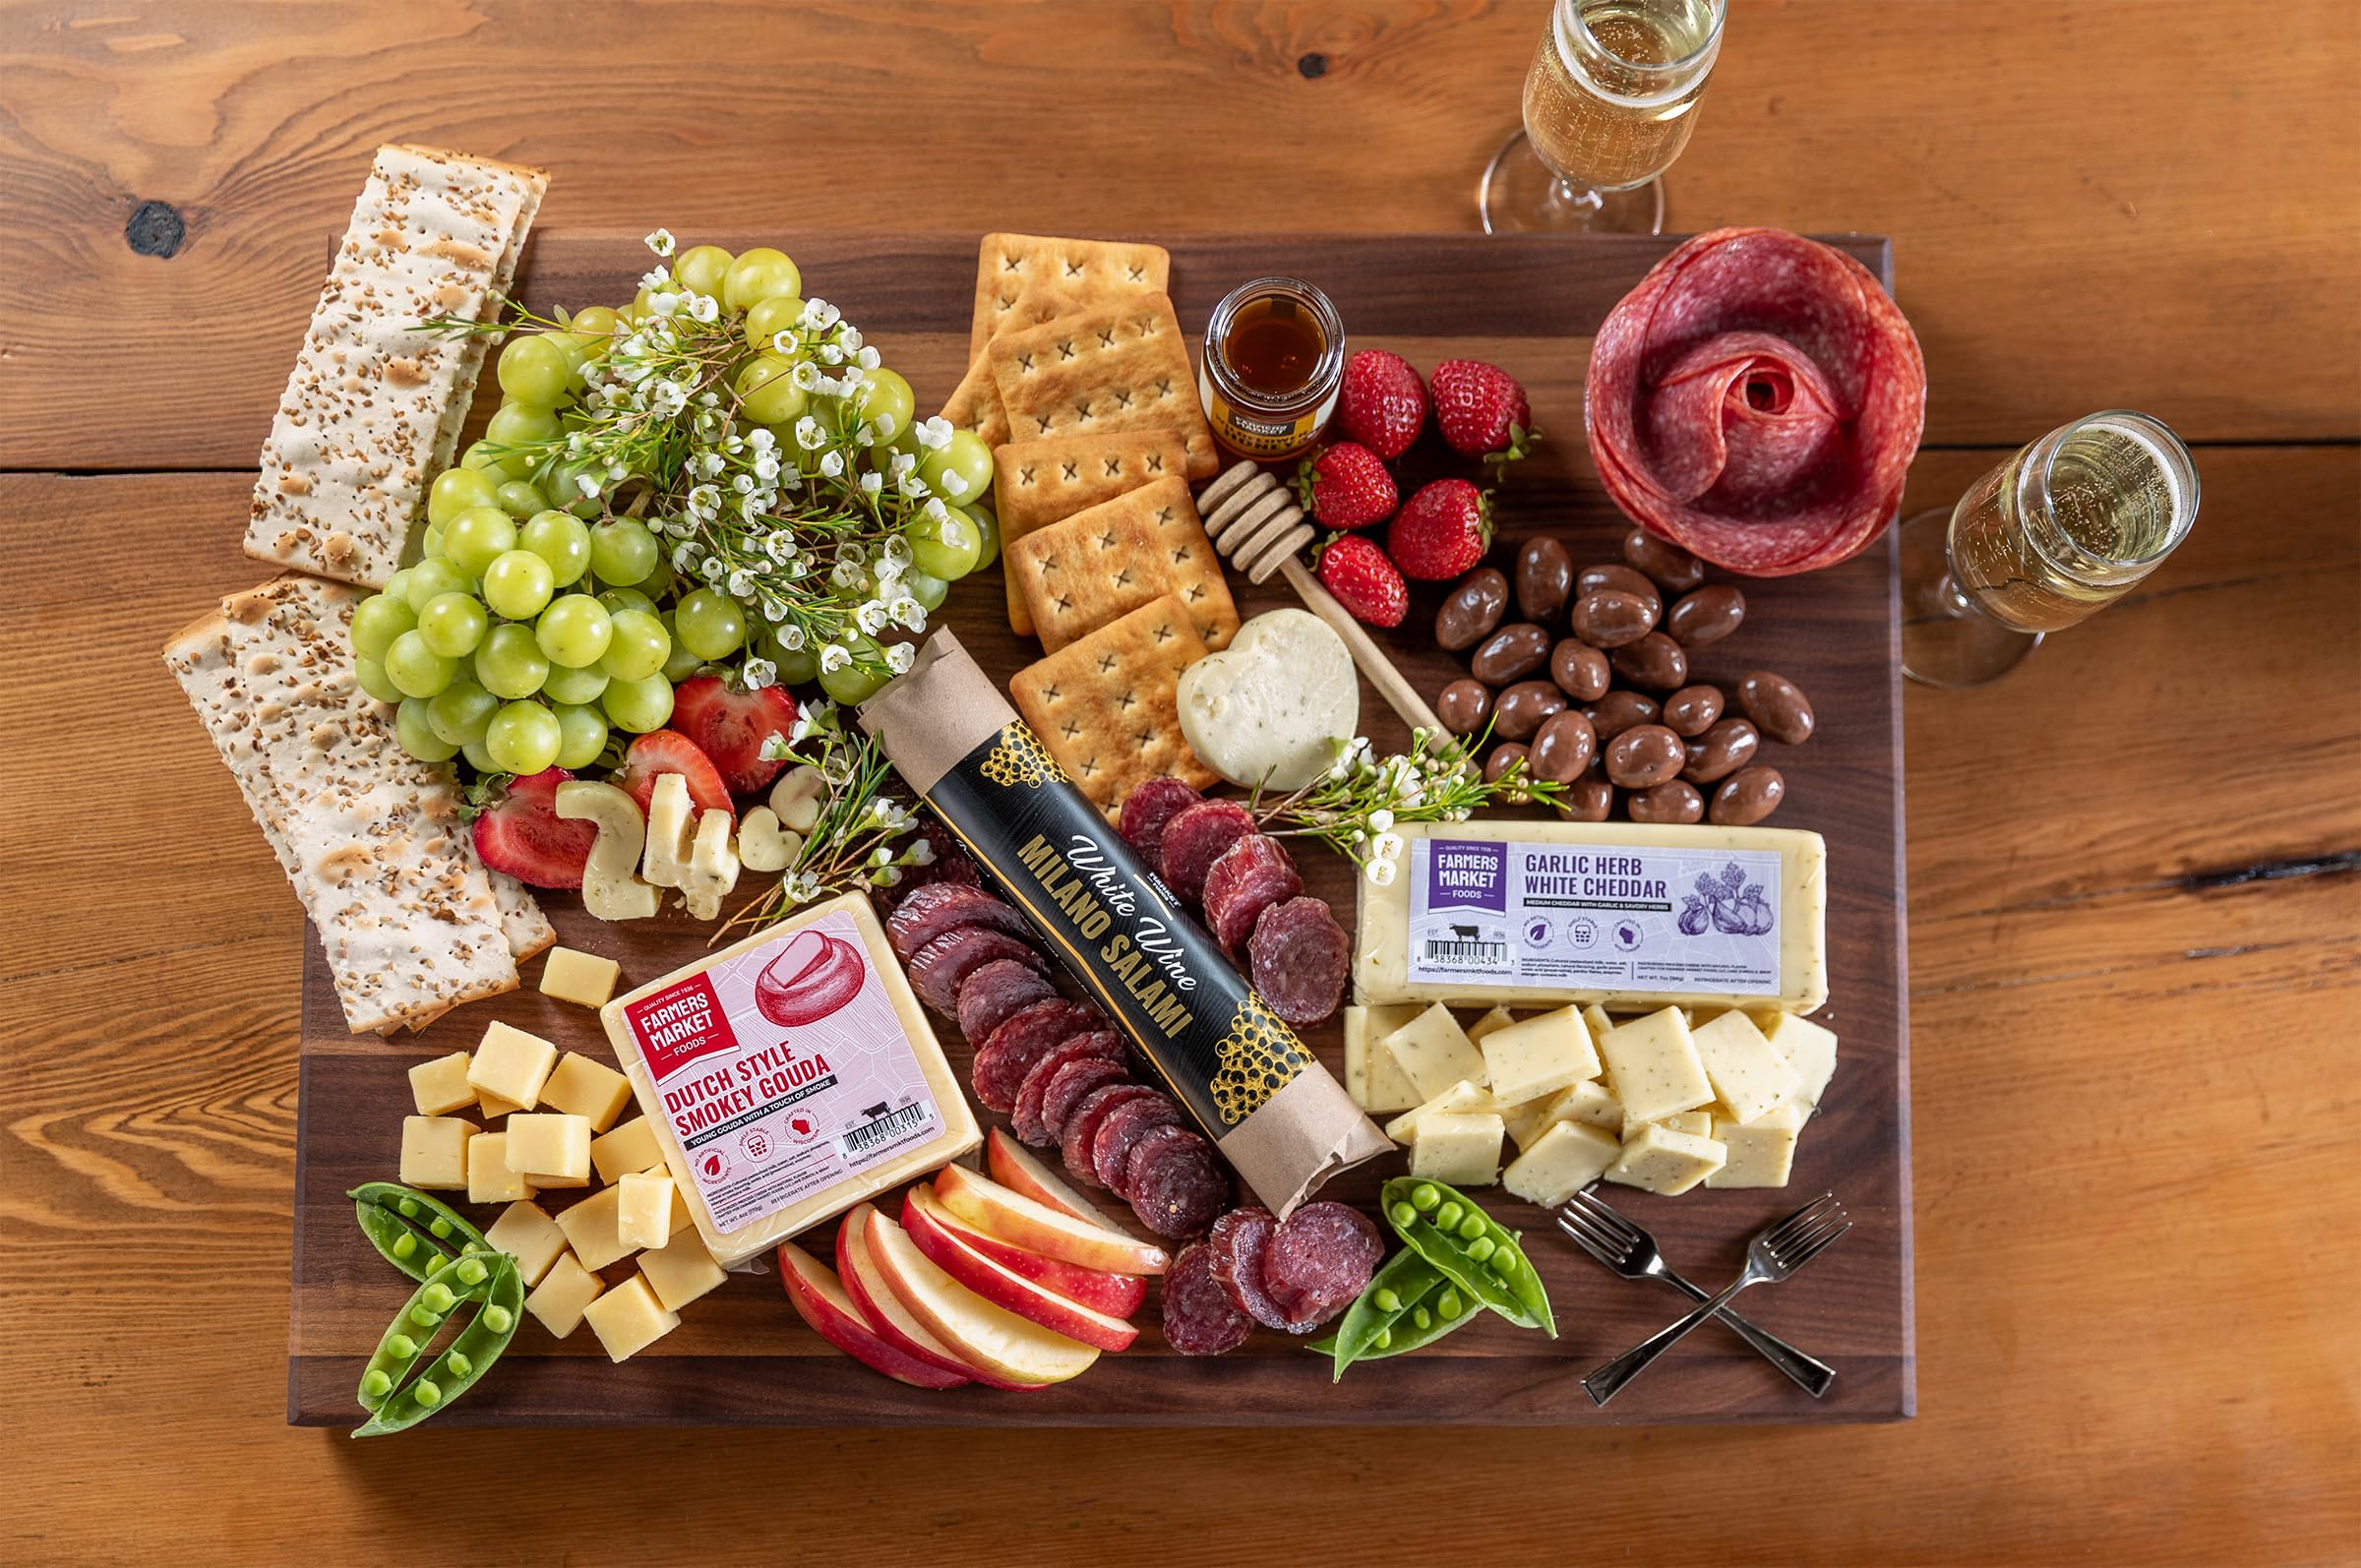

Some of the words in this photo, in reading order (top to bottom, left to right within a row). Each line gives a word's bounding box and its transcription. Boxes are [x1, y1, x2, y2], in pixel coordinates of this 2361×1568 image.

[1437, 853, 1498, 871] FARMERS
[1525, 854, 1589, 874] GARLIC
[1596, 857, 1641, 875] HERB
[1438, 870, 1496, 888] MARKET
[1525, 875, 1577, 894] WHITE
[1583, 877, 1665, 898] CHEDDAR
[1452, 889, 1482, 898] FOODS
[1067, 835, 1135, 916] White
[1134, 917, 1197, 991] Wine
[1016, 833, 1112, 940] MILANO
[1101, 935, 1194, 1039] SALAMI
[1418, 966, 1512, 975] https://farmersmktfoods.com
[1434, 954, 1463, 963] 38368
[642, 997, 665, 1010] QUALITY
[665, 991, 681, 1000] SINCE
[680, 985, 694, 994] 1936
[640, 992, 708, 1032] FARMERS
[649, 1009, 715, 1050] MARKET
[673, 1036, 706, 1055] FOODS
[665, 1068, 733, 1113] DUTCH
[736, 1041, 794, 1080] STYLE
[675, 1086, 757, 1136] SMOKEY
[758, 1053, 829, 1098] GOUDA
[691, 1130, 717, 1146] YOUNG
[717, 1118, 744, 1134] GOUDA
[743, 1110, 762, 1122] WITH
[768, 1096, 794, 1111] TOUCH
[794, 1091, 805, 1100] OF
[805, 1079, 830, 1094] SMOKE
[783, 1107, 804, 1123] CRAFTED
[849, 1125, 935, 1169] https://farmersmktfoods.com
[857, 1133, 886, 1152] 38368
[888, 1118, 918, 1137] 00315
